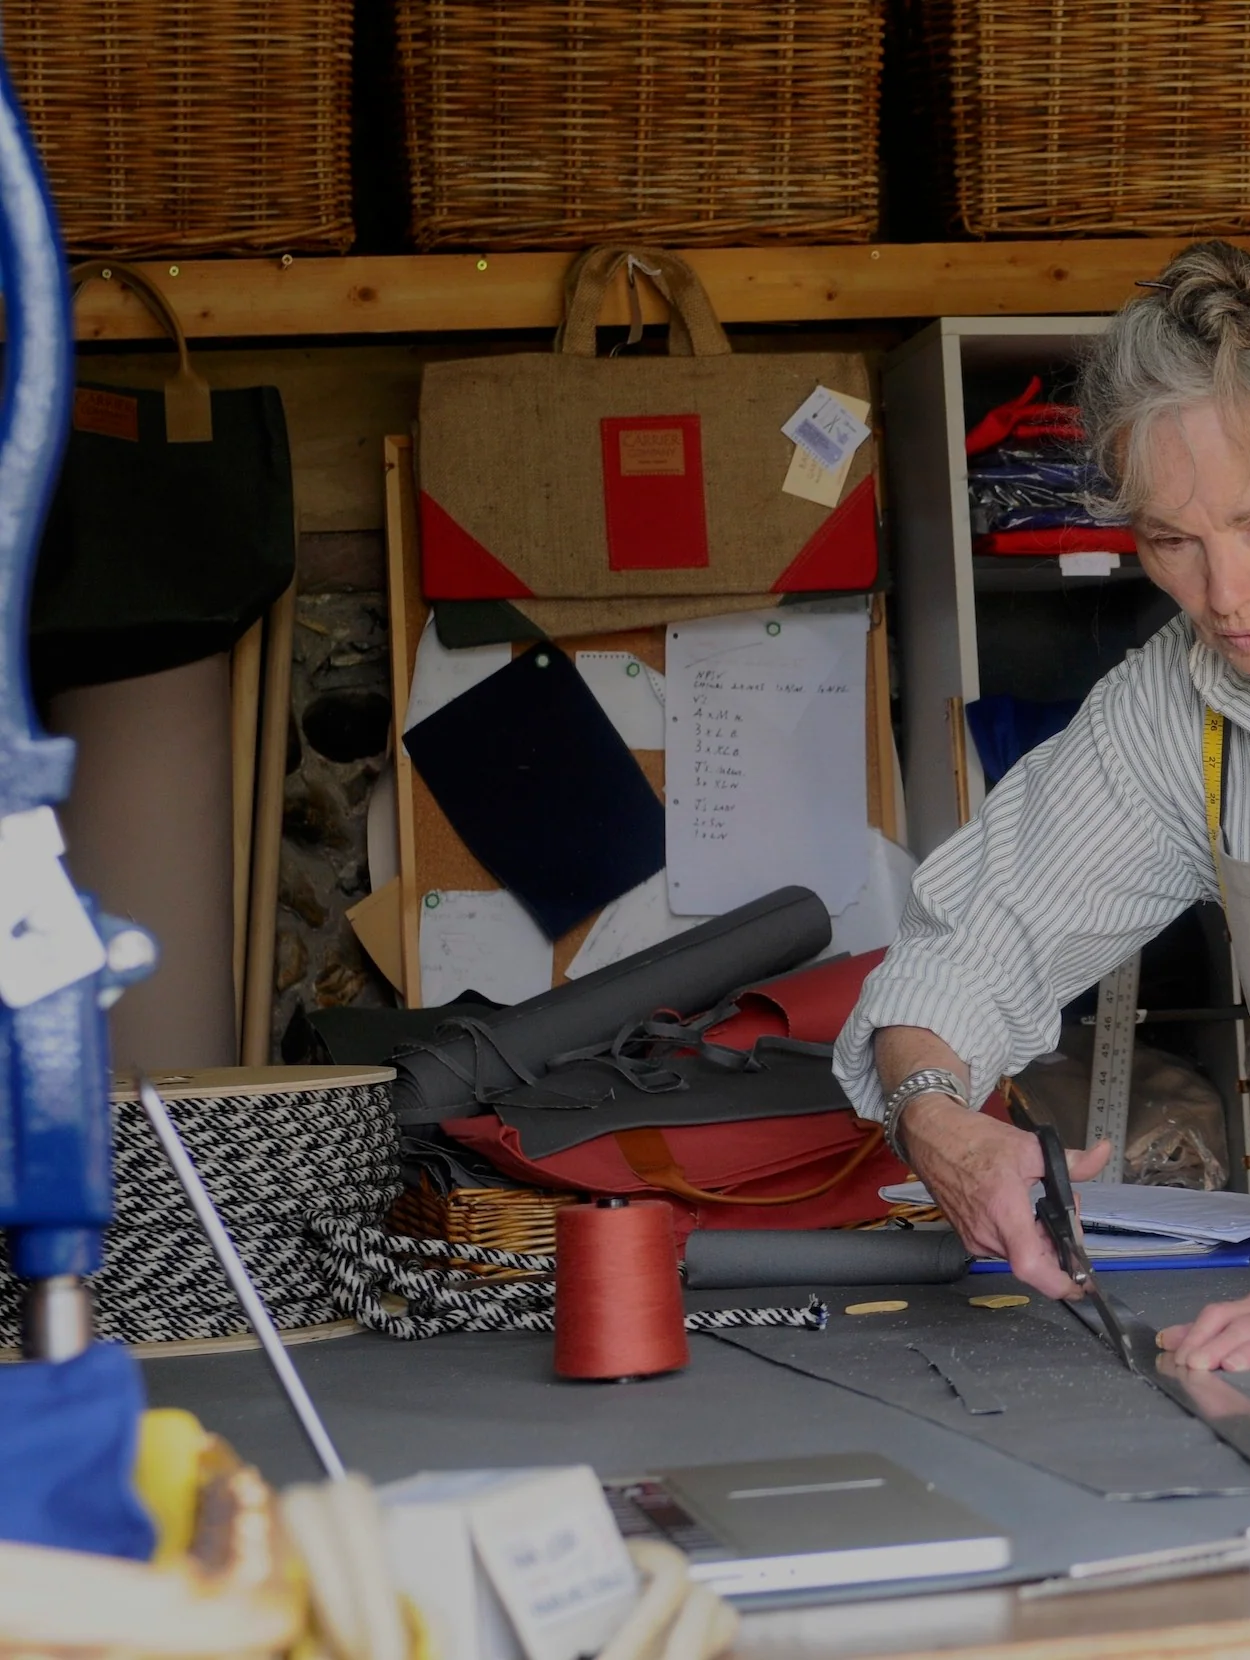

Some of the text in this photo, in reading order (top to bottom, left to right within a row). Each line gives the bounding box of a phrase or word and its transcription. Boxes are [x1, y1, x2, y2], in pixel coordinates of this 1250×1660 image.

[622, 432, 681, 447] CARRIER
[1210, 719, 1218, 732] 26
[1208, 756, 1216, 769] 27
[1105, 990, 1115, 1004] 47
[1104, 1016, 1112, 1031] 46
[1101, 1043, 1110, 1058] 45
[1099, 1071, 1107, 1086] 44
[1097, 1098, 1105, 1113] 43
[1095, 1125, 1104, 1139] 42
